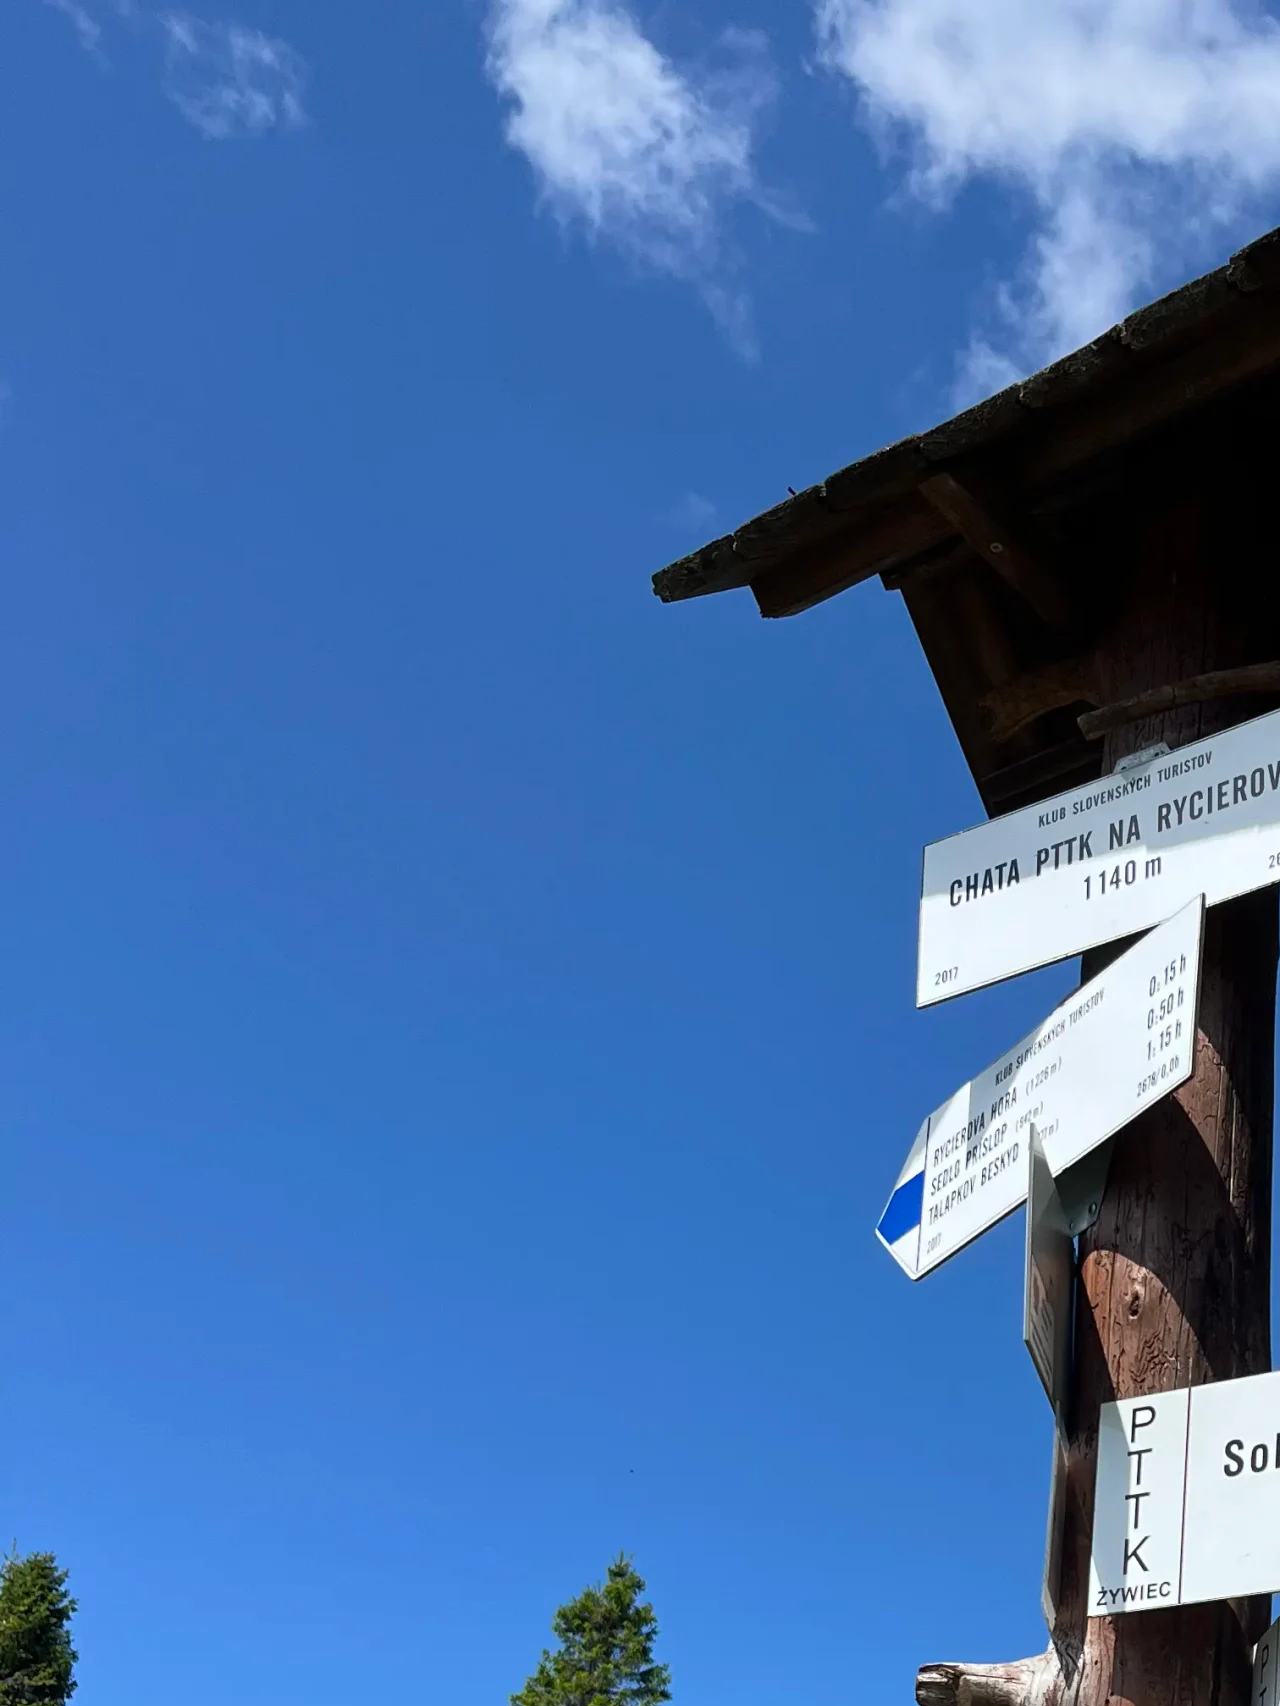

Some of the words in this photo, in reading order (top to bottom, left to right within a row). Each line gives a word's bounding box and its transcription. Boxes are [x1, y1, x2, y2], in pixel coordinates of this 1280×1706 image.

[1038, 807, 1066, 828] KLUB
[1073, 774, 1151, 815] SLOVENSKÝCH
[1157, 751, 1212, 783] TURISTOV
[950, 858, 1020, 907] CHATA
[1036, 830, 1093, 877] PTTK
[1109, 813, 1141, 851] NA
[1083, 859, 1137, 901] 1140
[1144, 857, 1162, 877] m
[935, 966, 959, 986] 2017
[995, 1062, 1013, 1086] KLUB
[1069, 988, 1105, 1027] TURISTOV
[934, 1112, 985, 1168] RYCIEROVA
[991, 1087, 1018, 1122] HORA
[929, 1175, 976, 1225] TALAPKOV
[981, 1143, 1019, 1187] BESKYD
[931, 1158, 961, 1196] SEDLO
[1096, 1581, 1172, 1606] ŻYWIEC
